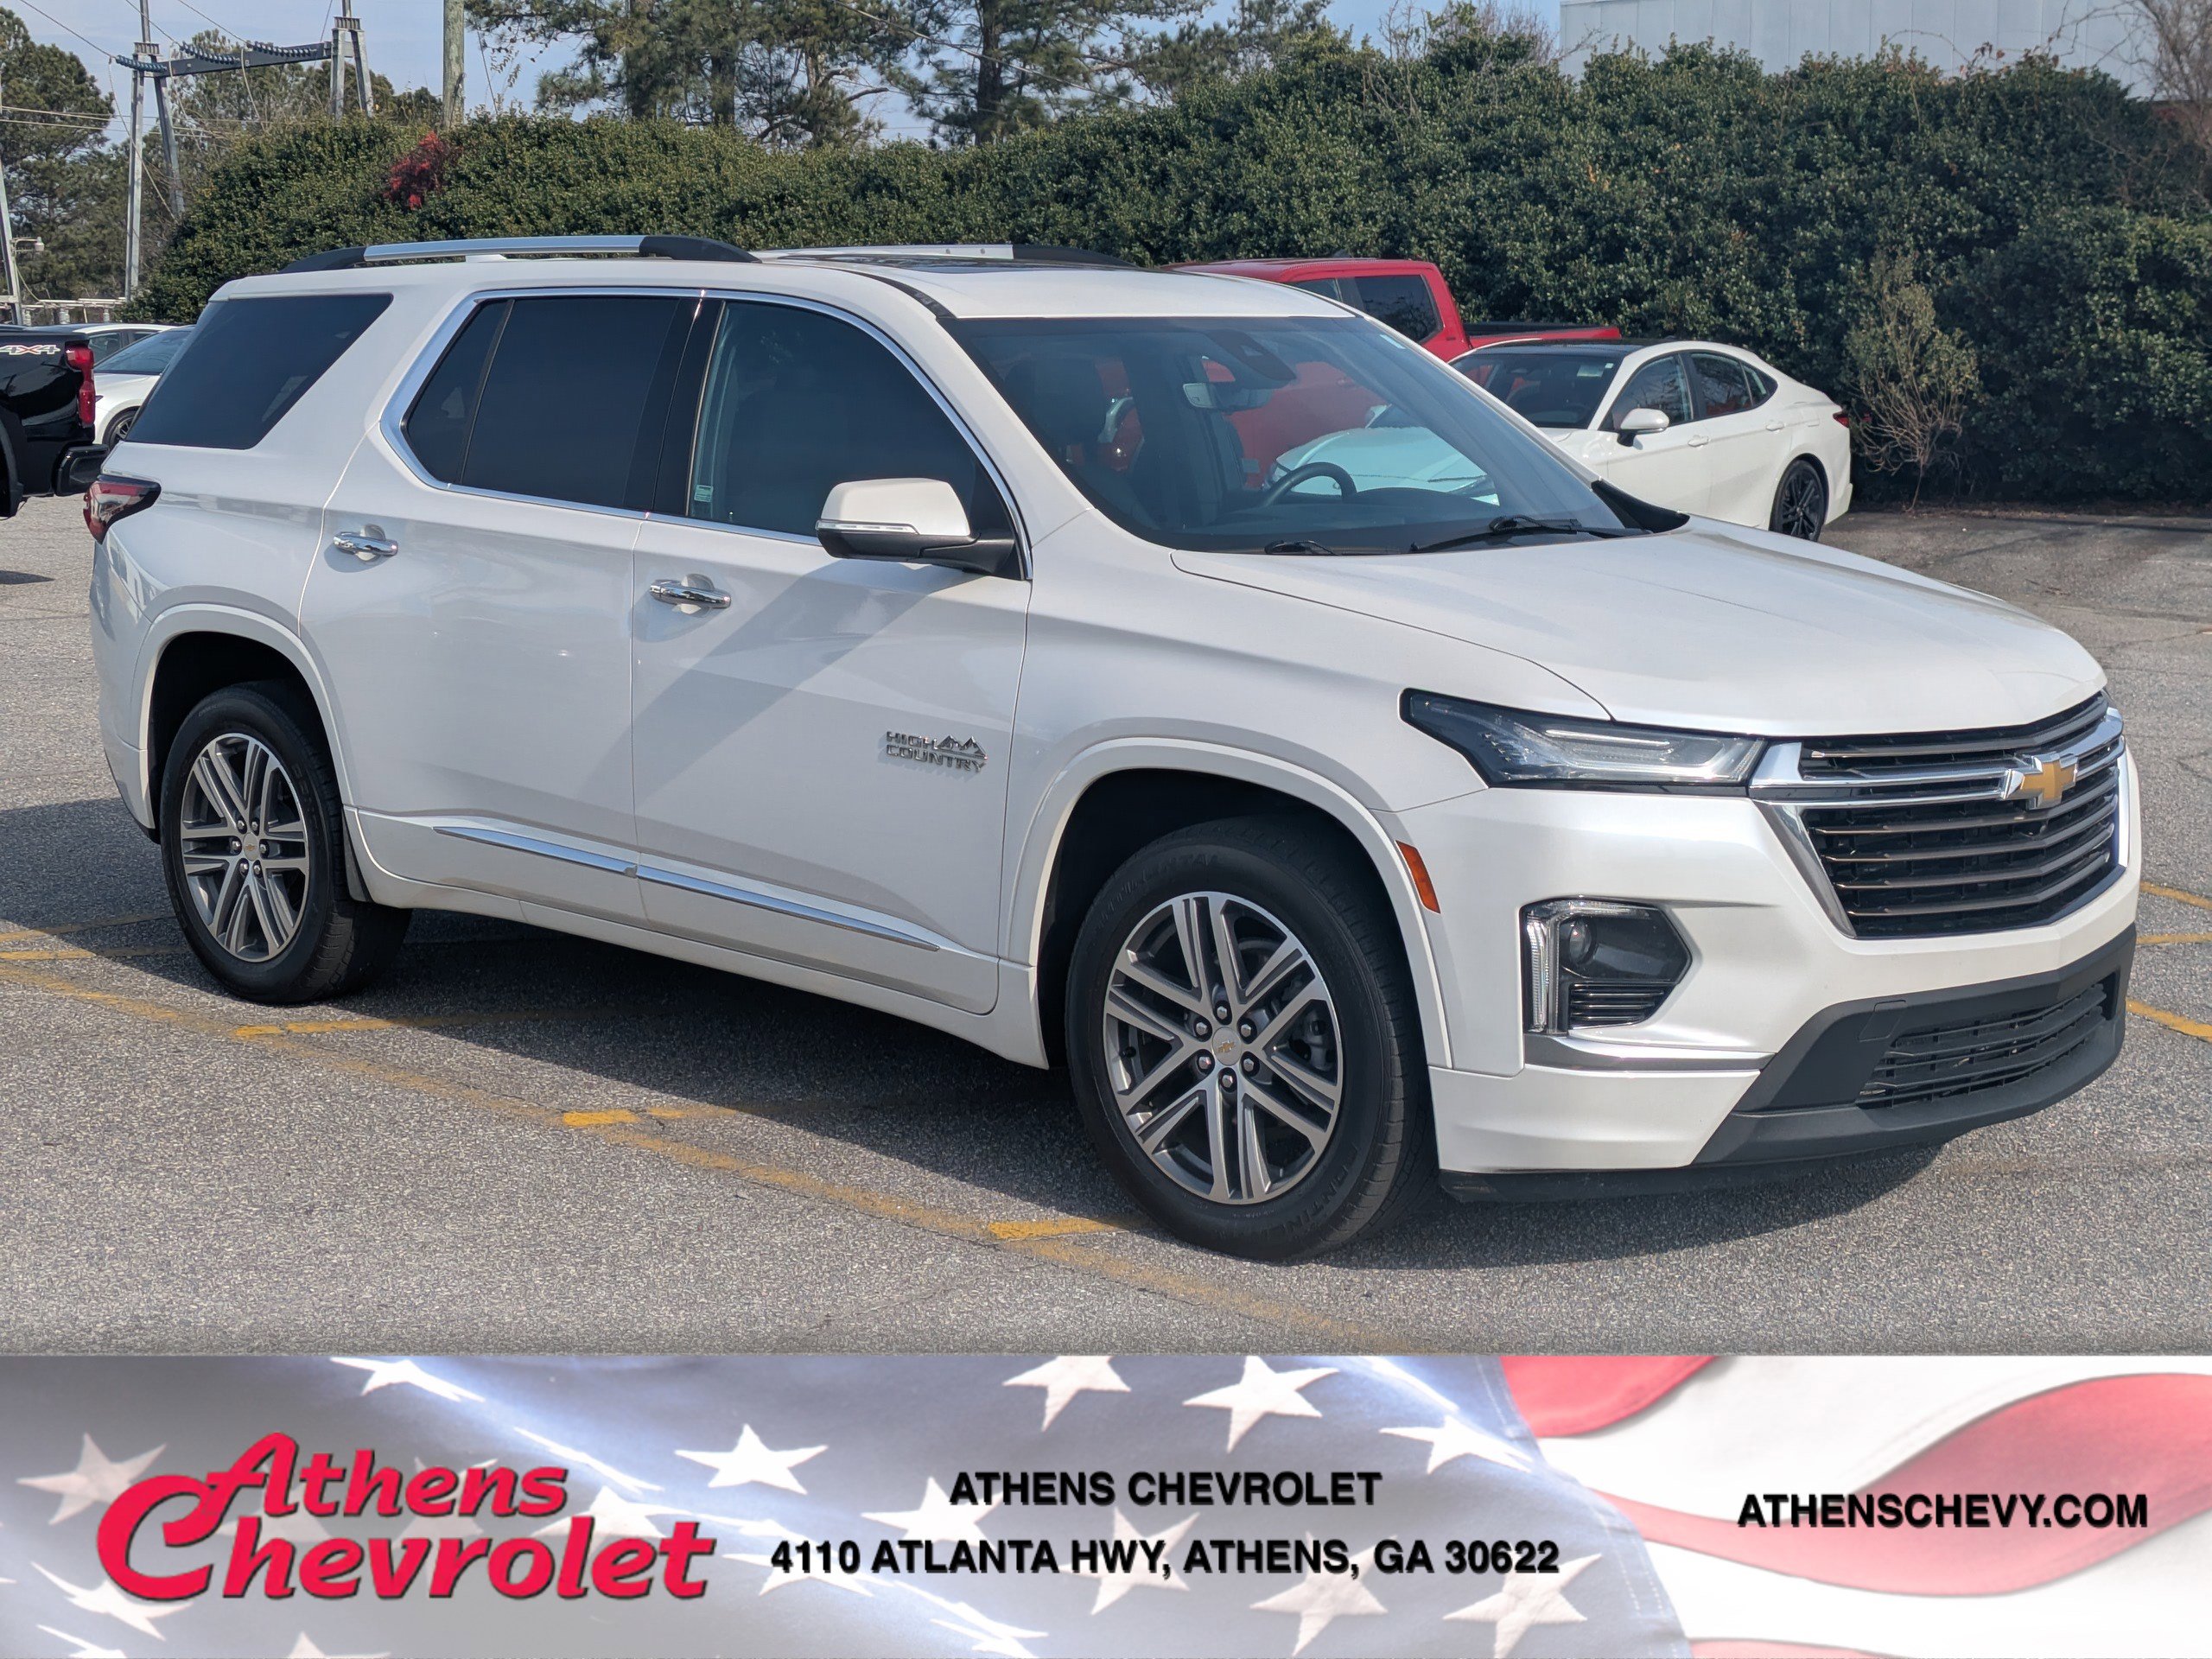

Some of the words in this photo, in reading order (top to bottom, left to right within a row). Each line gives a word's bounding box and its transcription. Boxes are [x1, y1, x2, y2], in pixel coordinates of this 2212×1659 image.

[0, 345, 61, 355] 4X4
[886, 731, 938, 750] HIGH
[886, 744, 986, 772] COUNTRY
